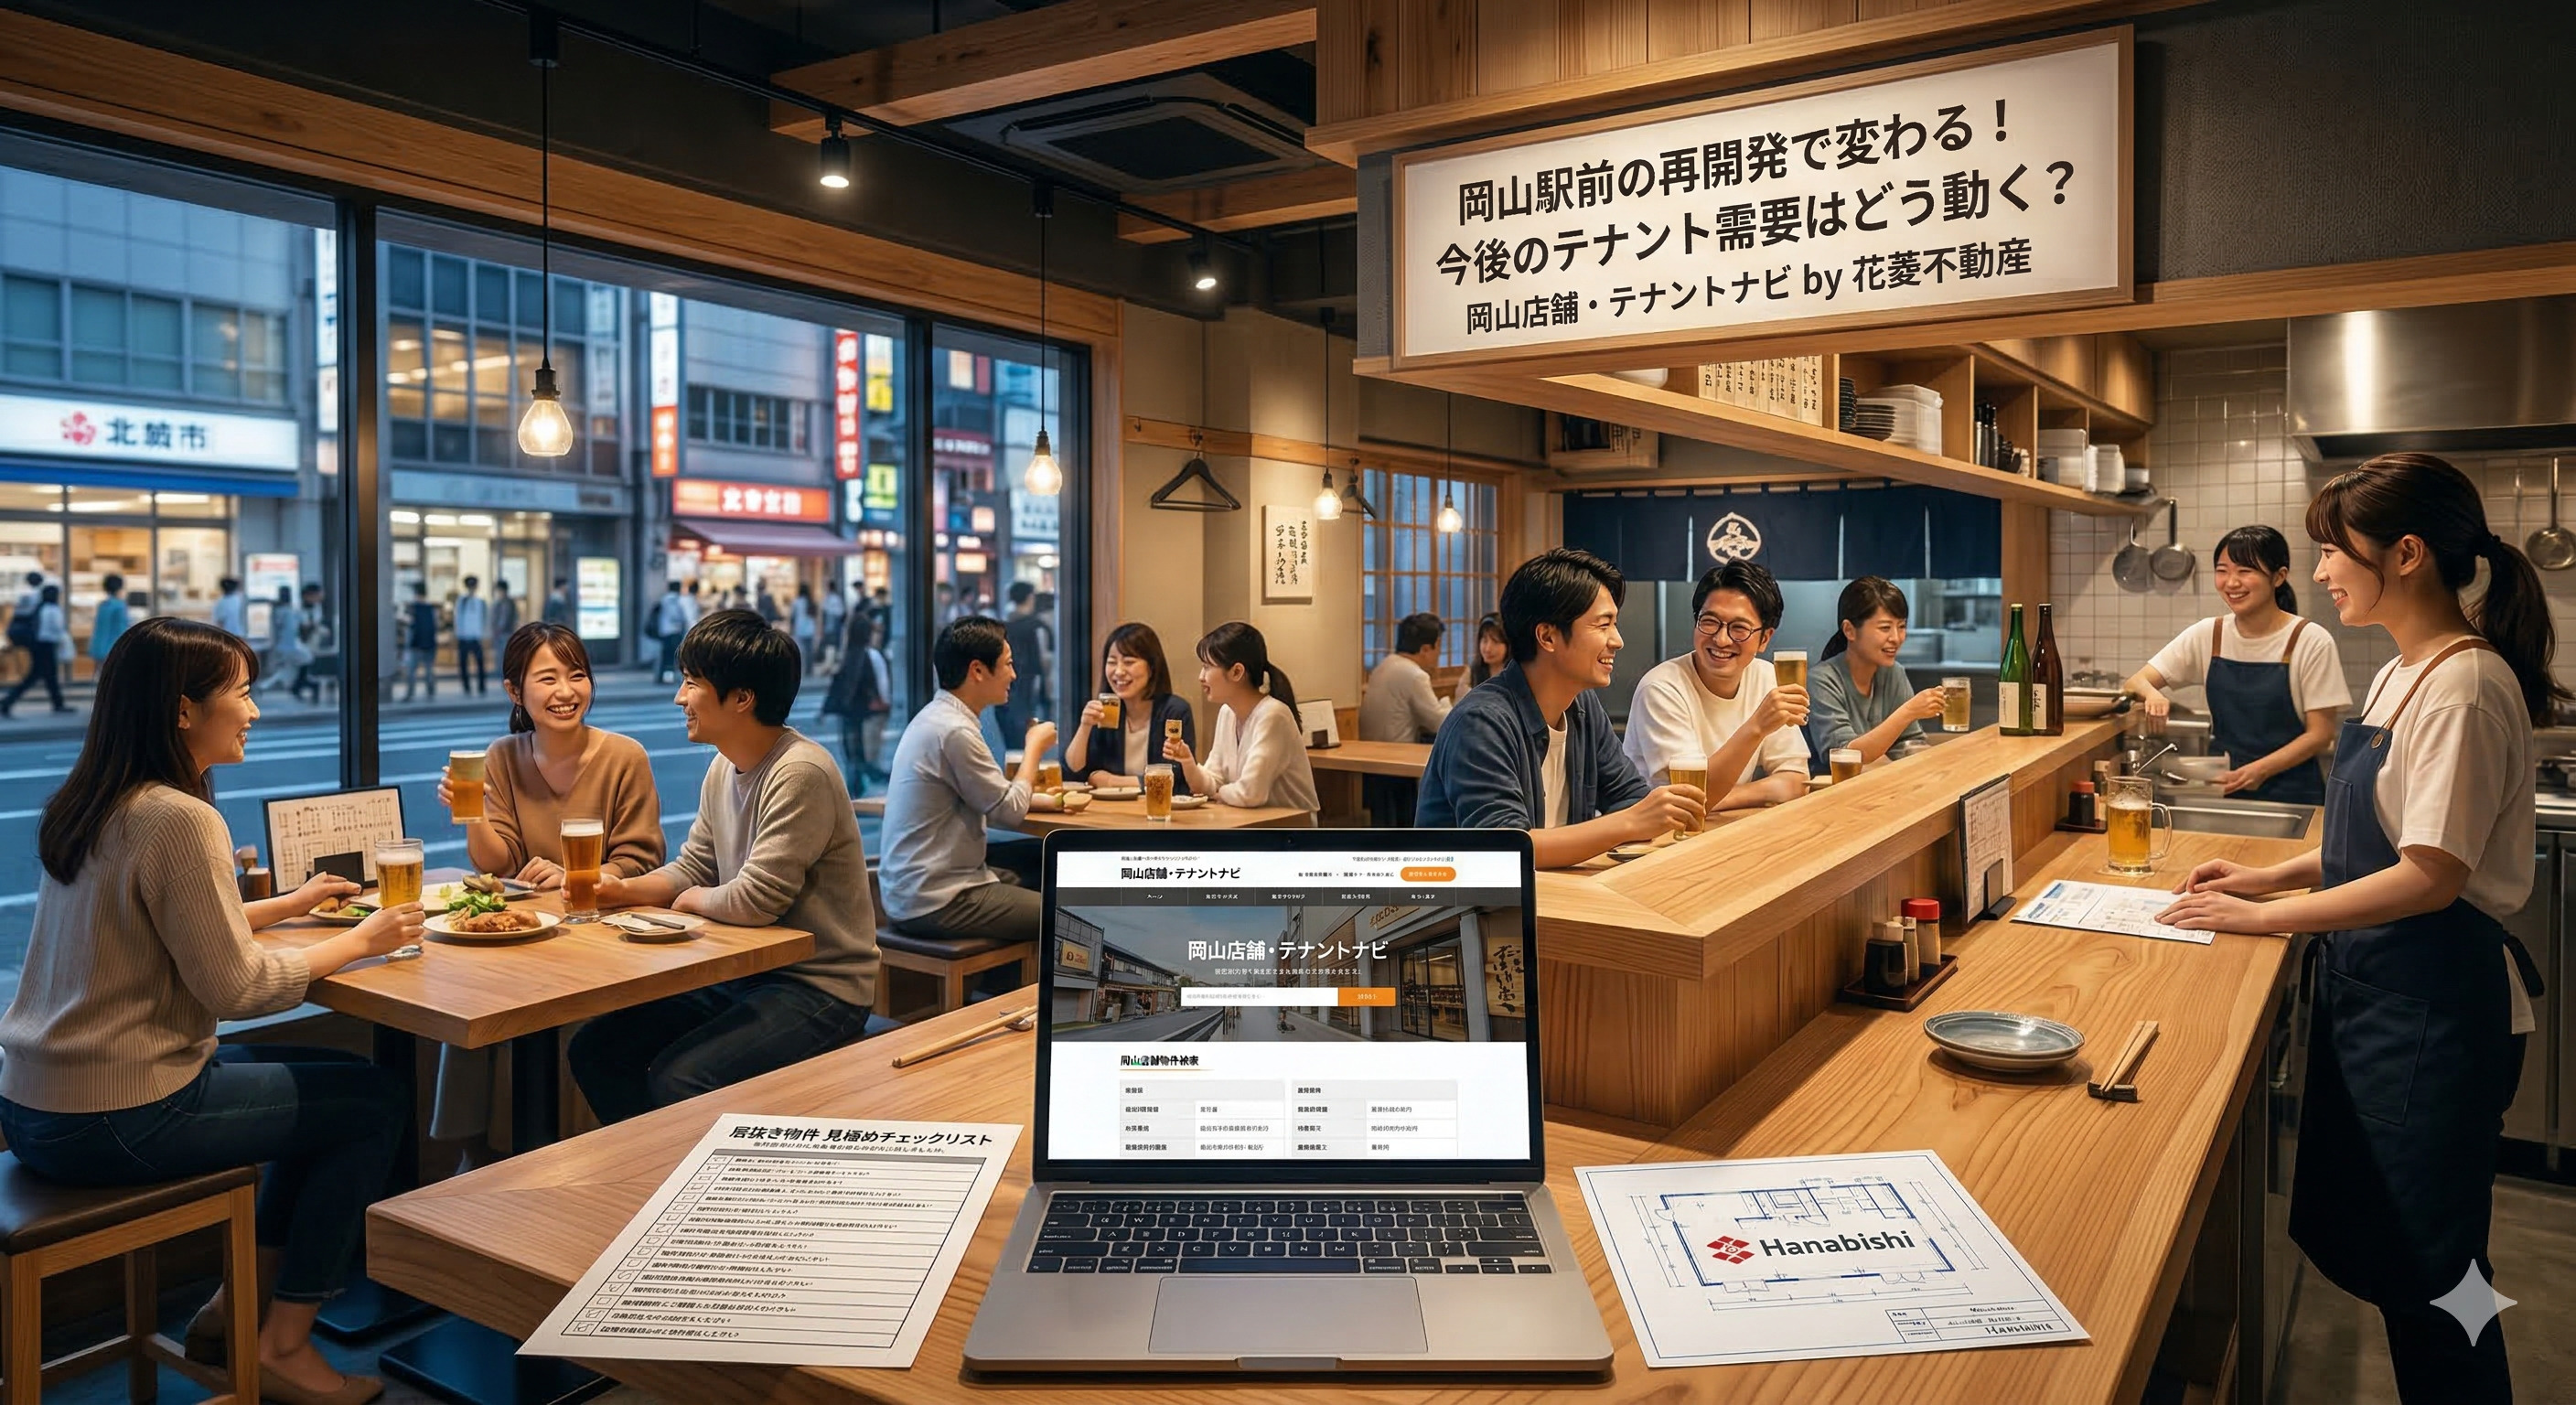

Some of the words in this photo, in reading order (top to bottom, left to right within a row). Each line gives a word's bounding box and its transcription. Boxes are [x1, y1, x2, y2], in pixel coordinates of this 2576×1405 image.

[1459, 98, 2007, 226] 岡山駅前の再開発で変わる！
[1435, 160, 2075, 286] 今後のテナント需要はどう動く？
[1466, 264, 1792, 335] 岡山店舗・テナントナビ
[1803, 263, 1843, 301] by
[1852, 237, 2032, 293] 花菱不動産
[1188, 939, 1389, 960] 岡山店舗・テナントナビ
[1759, 1230, 1916, 1257] Hanabishi
